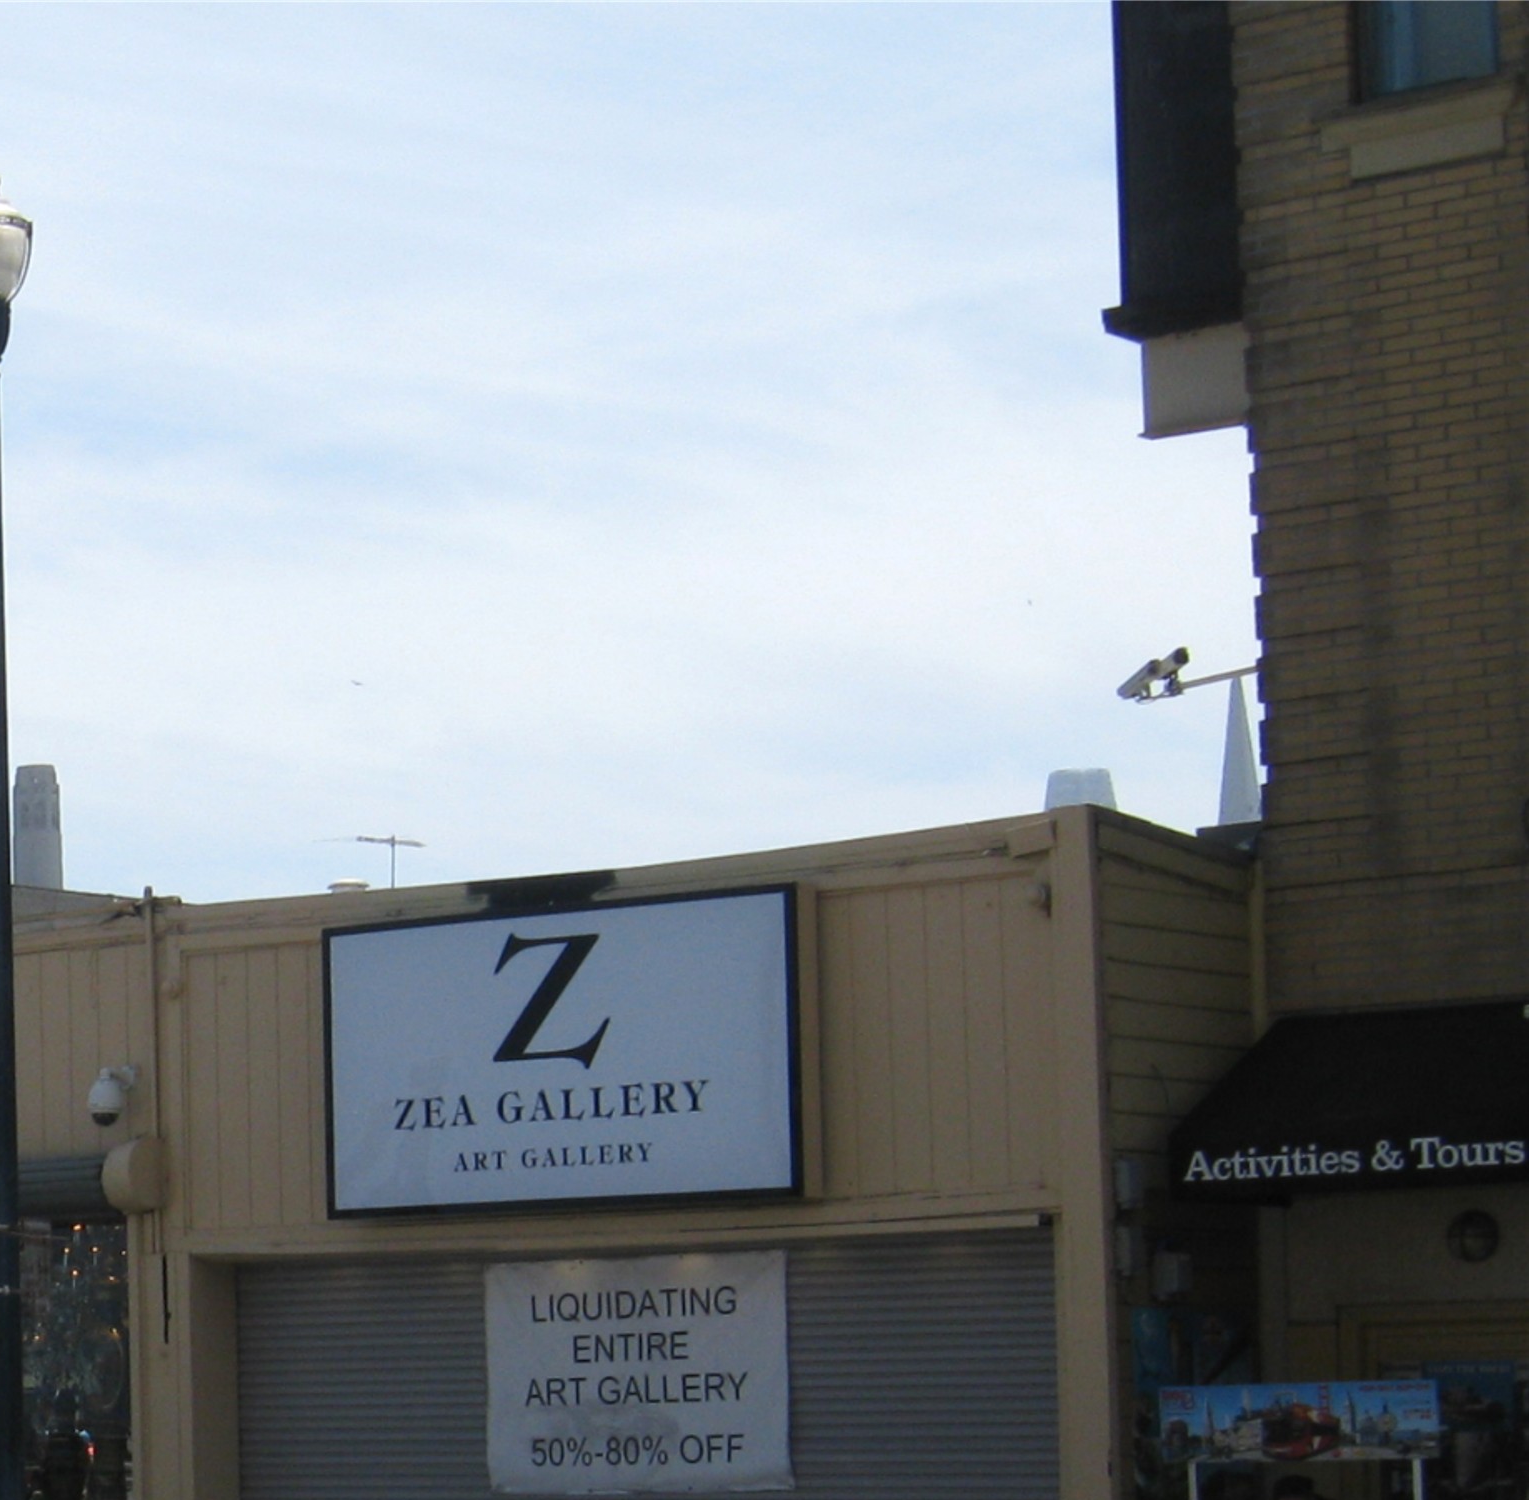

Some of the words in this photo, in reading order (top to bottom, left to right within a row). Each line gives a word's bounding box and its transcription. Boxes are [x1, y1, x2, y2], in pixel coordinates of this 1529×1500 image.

[492, 932, 612, 1069] Z
[394, 1094, 477, 1132] ZEA
[497, 1079, 710, 1126] GALLERY
[453, 1149, 508, 1174] ART
[520, 1142, 654, 1170] GALLERY
[1183, 1144, 1360, 1181] Activities
[1370, 1139, 1404, 1172] &
[1410, 1136, 1526, 1170] Tours
[530, 1286, 738, 1325] LIQUIDATING
[571, 1329, 690, 1363] ENTIRE
[525, 1375, 586, 1408] ART
[598, 1371, 749, 1405] GALLERY
[530, 1435, 669, 1469] 50%-80%
[679, 1433, 745, 1465] OFF
